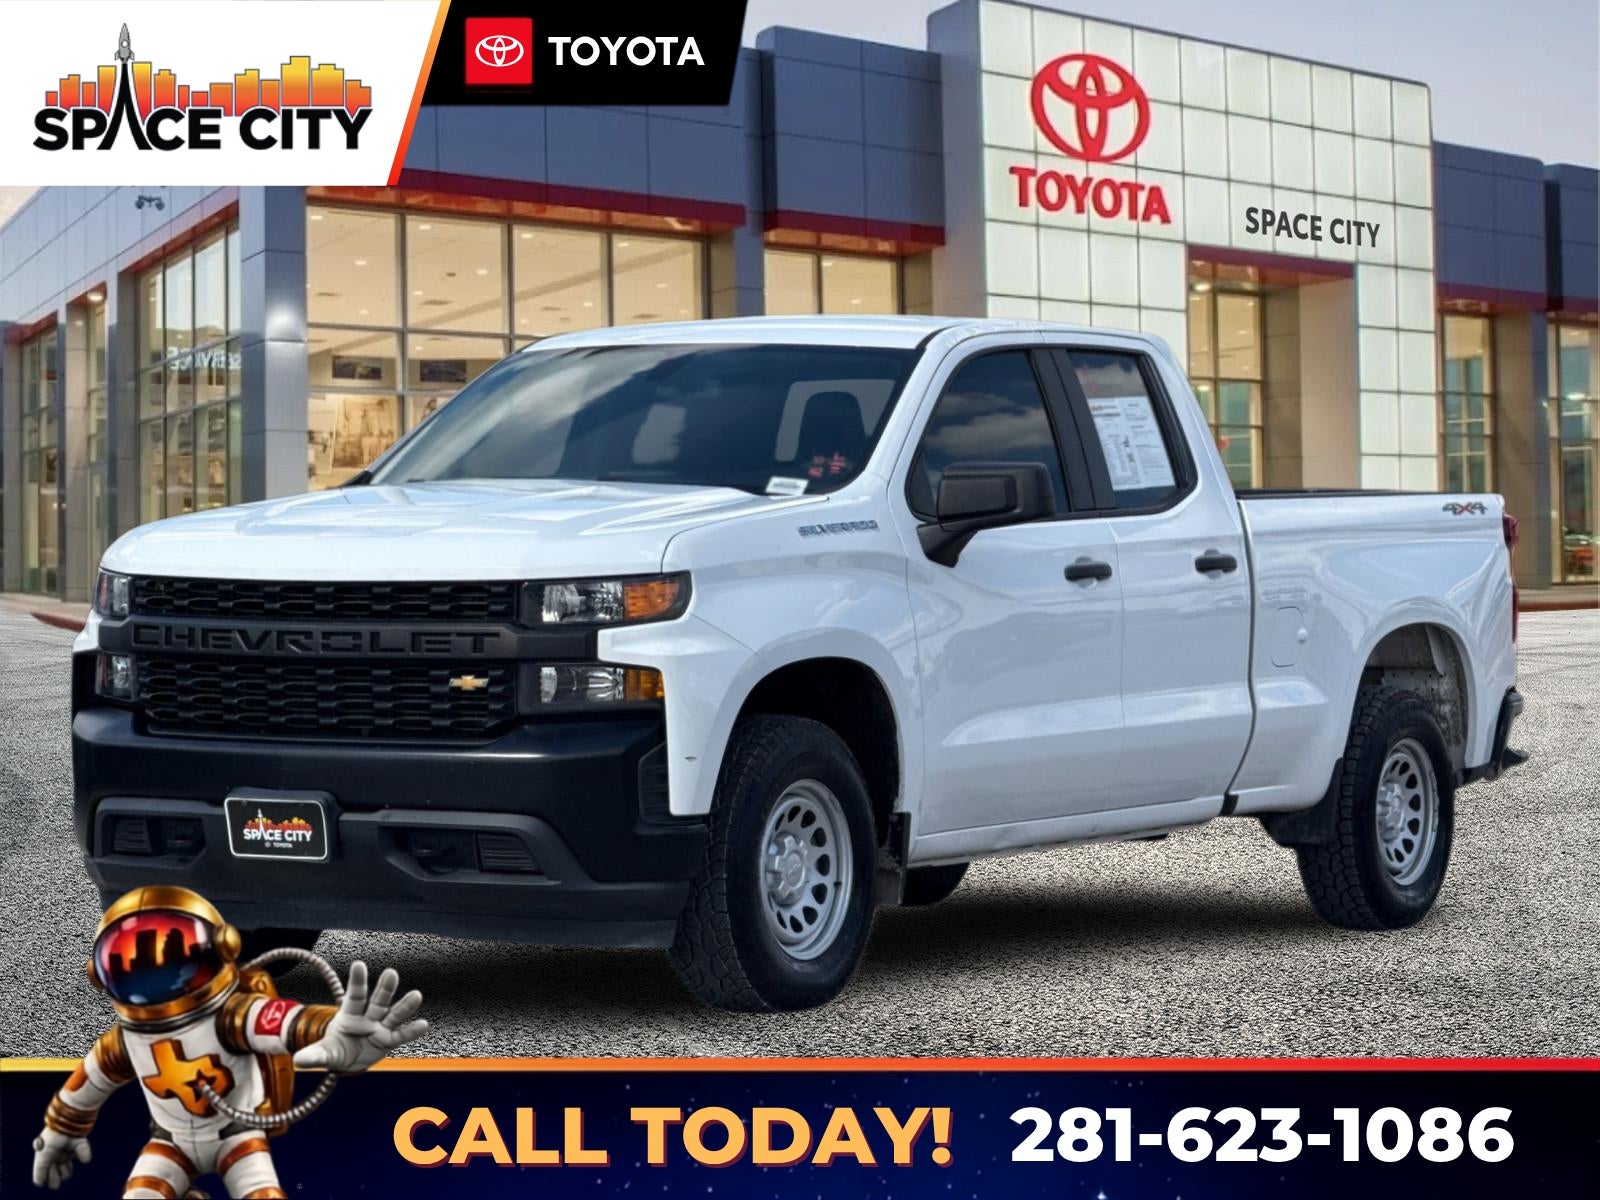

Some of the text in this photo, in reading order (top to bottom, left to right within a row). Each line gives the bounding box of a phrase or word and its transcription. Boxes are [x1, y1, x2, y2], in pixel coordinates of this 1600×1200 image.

[1009, 166, 1171, 224] TOYOTA
[1245, 206, 1381, 248] SPACE CITY
[131, 622, 501, 655] CHEVROLET
[243, 820, 312, 842] SPACE CITY
